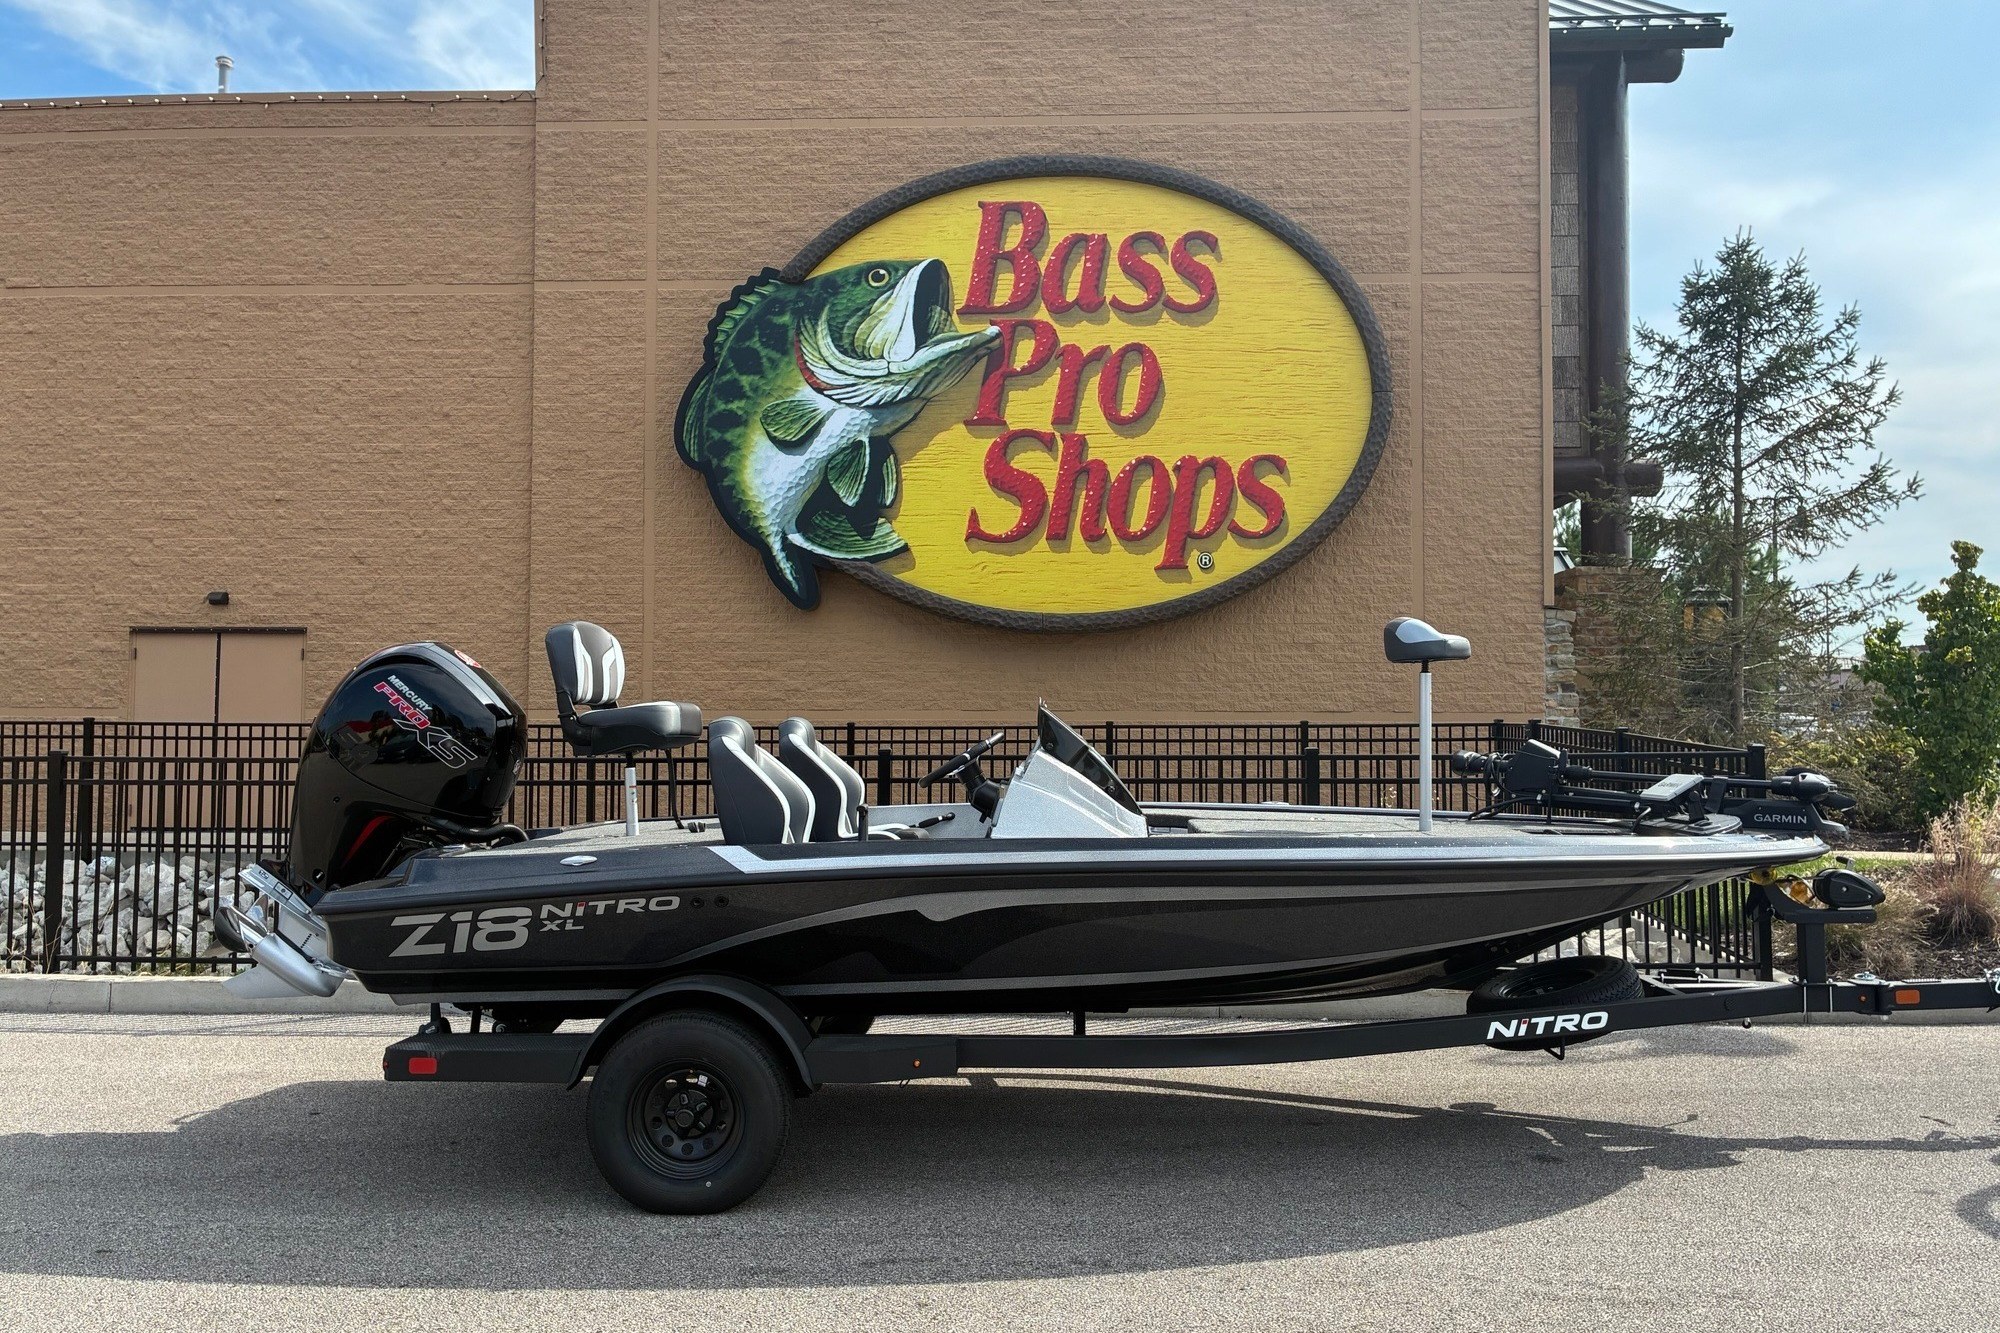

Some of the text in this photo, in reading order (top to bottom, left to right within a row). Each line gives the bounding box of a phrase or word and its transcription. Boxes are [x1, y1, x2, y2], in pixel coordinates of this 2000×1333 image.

[956, 201, 1219, 315] Bass
[963, 319, 1163, 426] Pro
[965, 428, 1287, 570] Shops
[373, 681, 431, 729] PRO
[387, 675, 433, 711] MERCURY
[392, 718, 478, 769] XS
[1753, 813, 1807, 824] GARMIN
[388, 906, 533, 957] Z18
[539, 919, 585, 932] XL
